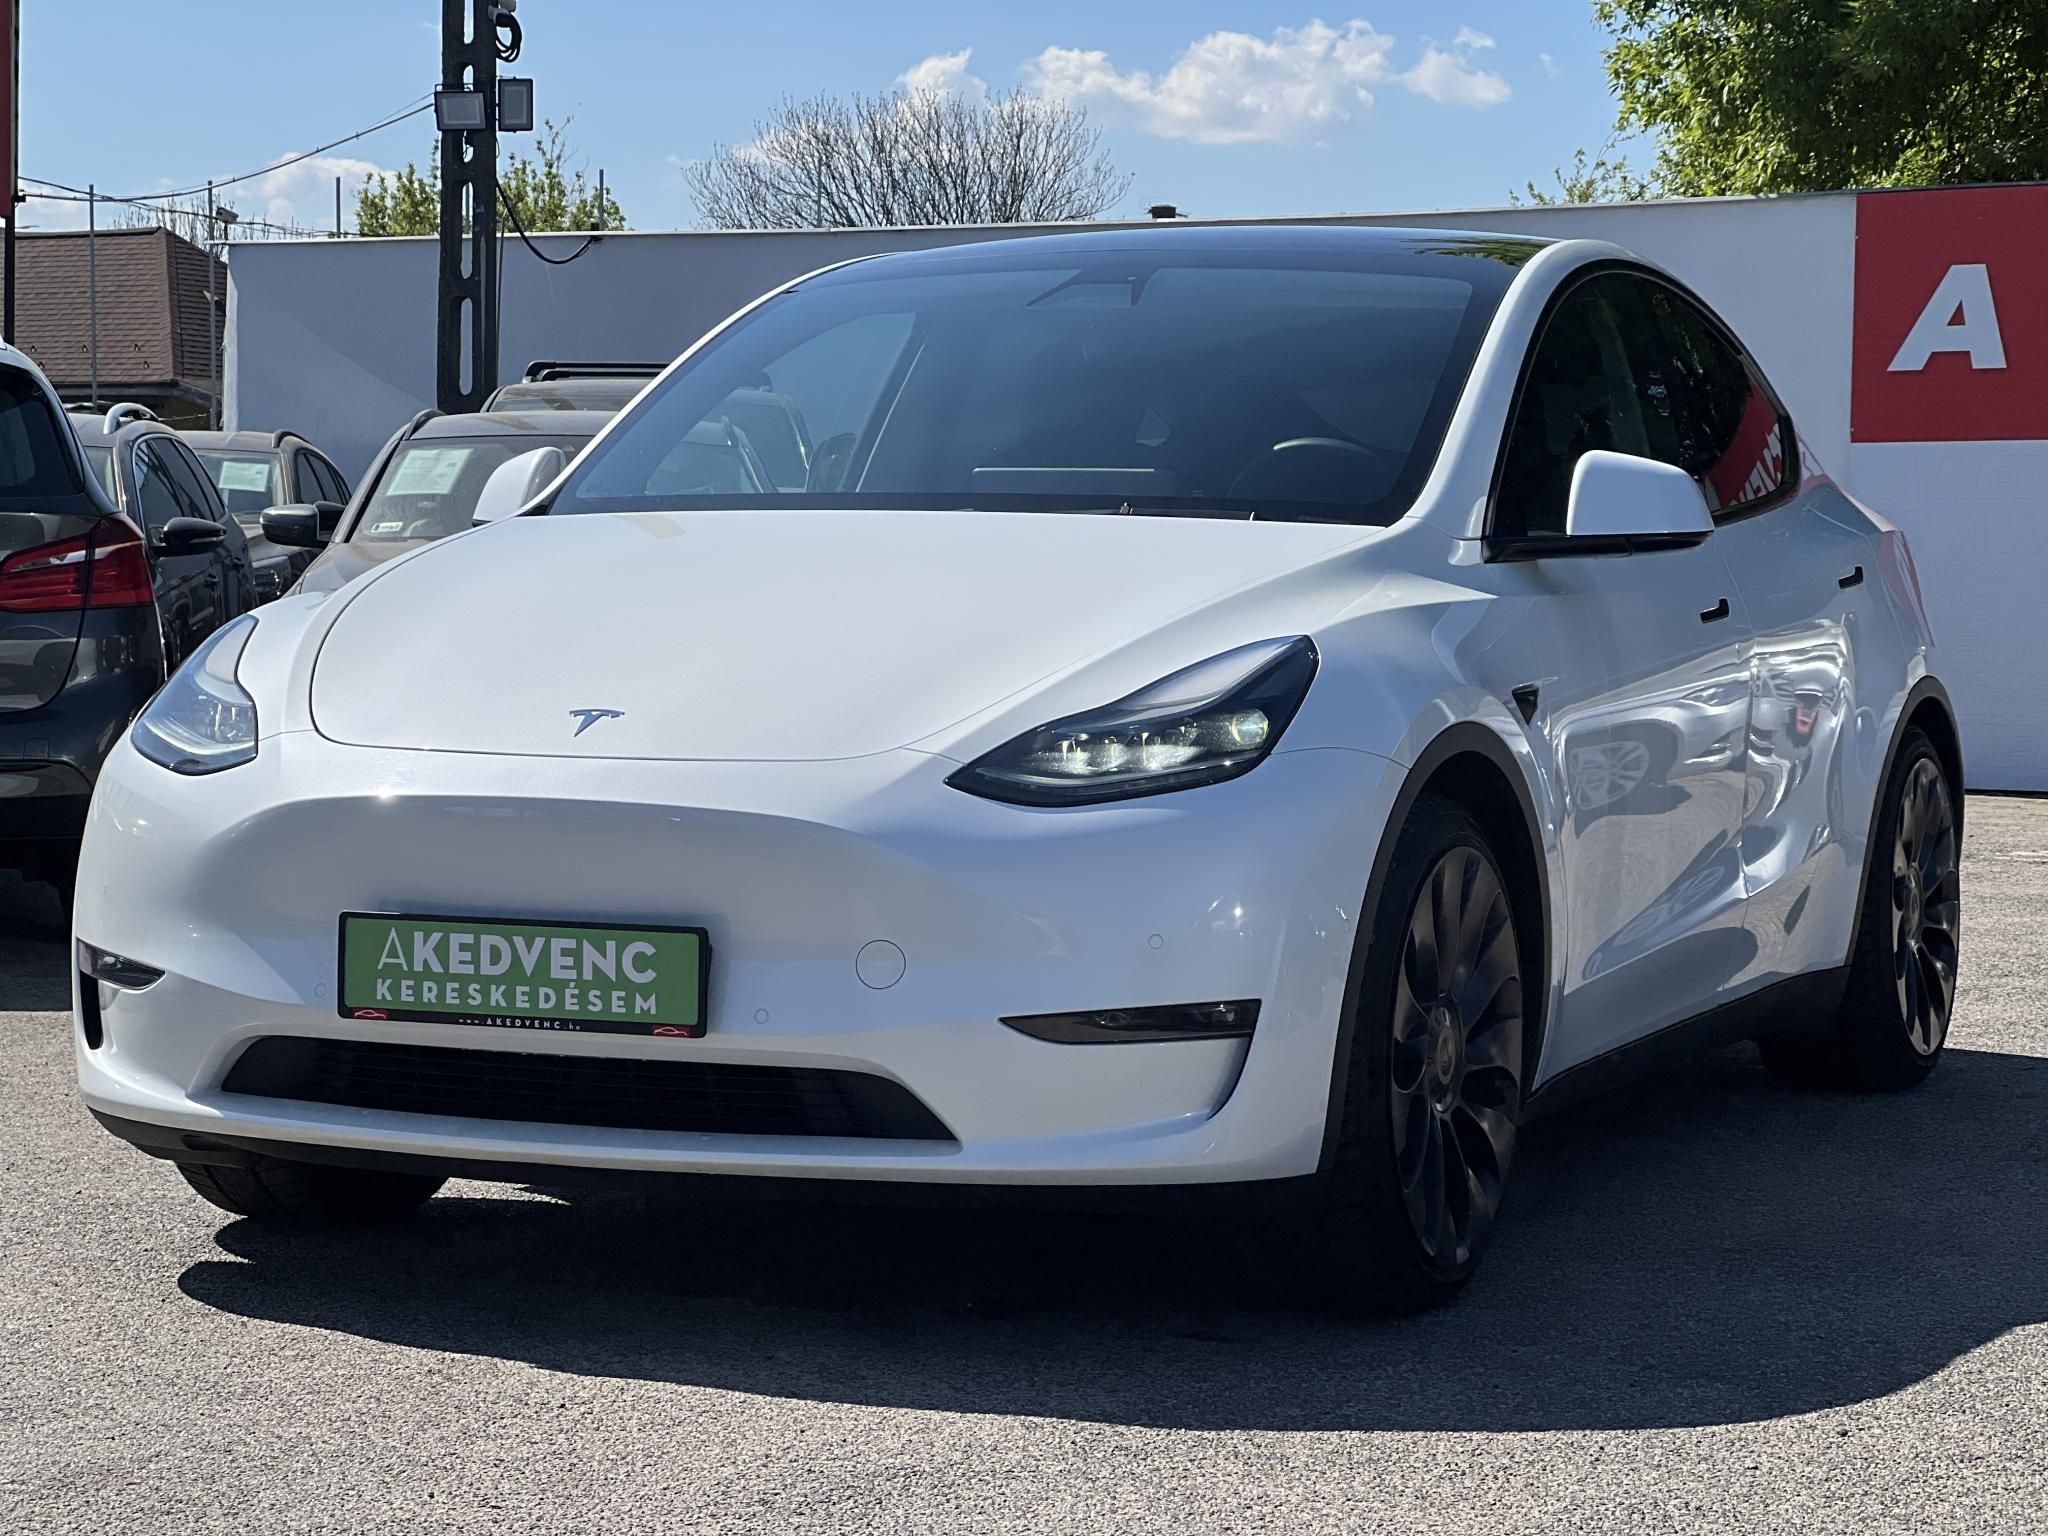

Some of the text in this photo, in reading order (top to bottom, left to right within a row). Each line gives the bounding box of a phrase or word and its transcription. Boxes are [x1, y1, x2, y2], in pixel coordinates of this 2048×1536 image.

[1887, 263, 2007, 372] A
[377, 927, 657, 984] AKEDVENC
[376, 978, 656, 1015] KERESKEDÉSEM
[458, 1017, 580, 1031] www.AKEDVENC.hu
